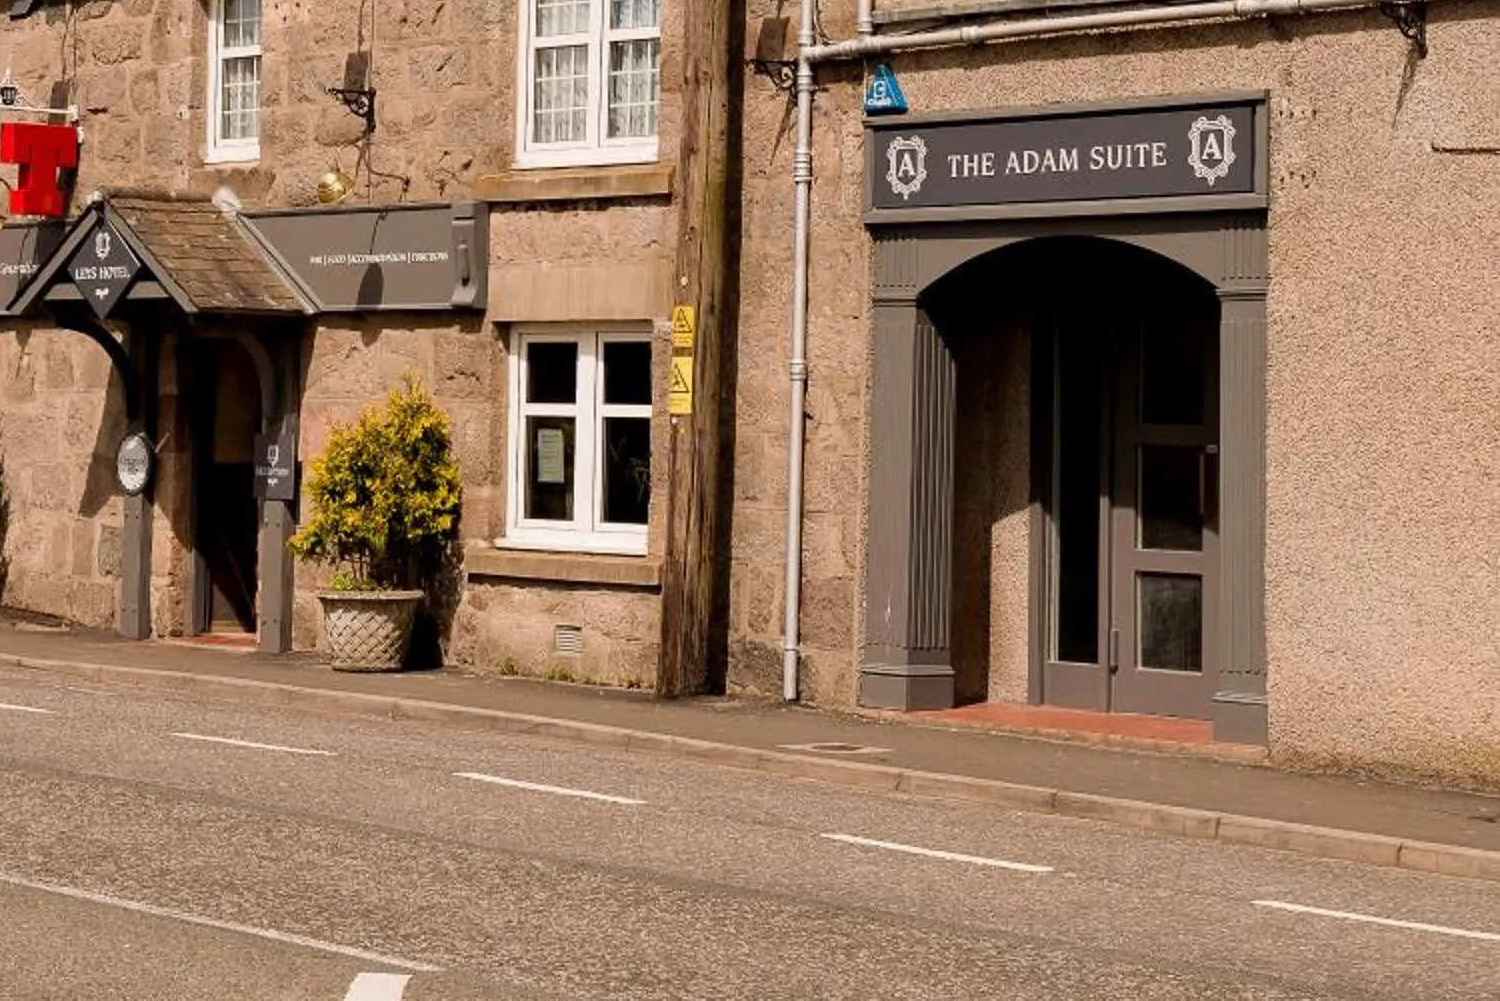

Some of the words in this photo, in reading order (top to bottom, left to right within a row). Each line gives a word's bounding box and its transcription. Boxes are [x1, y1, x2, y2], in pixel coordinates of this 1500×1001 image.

[948, 153, 996, 178] THE
[1005, 147, 1079, 175] ADAM
[1089, 142, 1168, 171] SUITE
[99, 265, 131, 280] HOTEL
